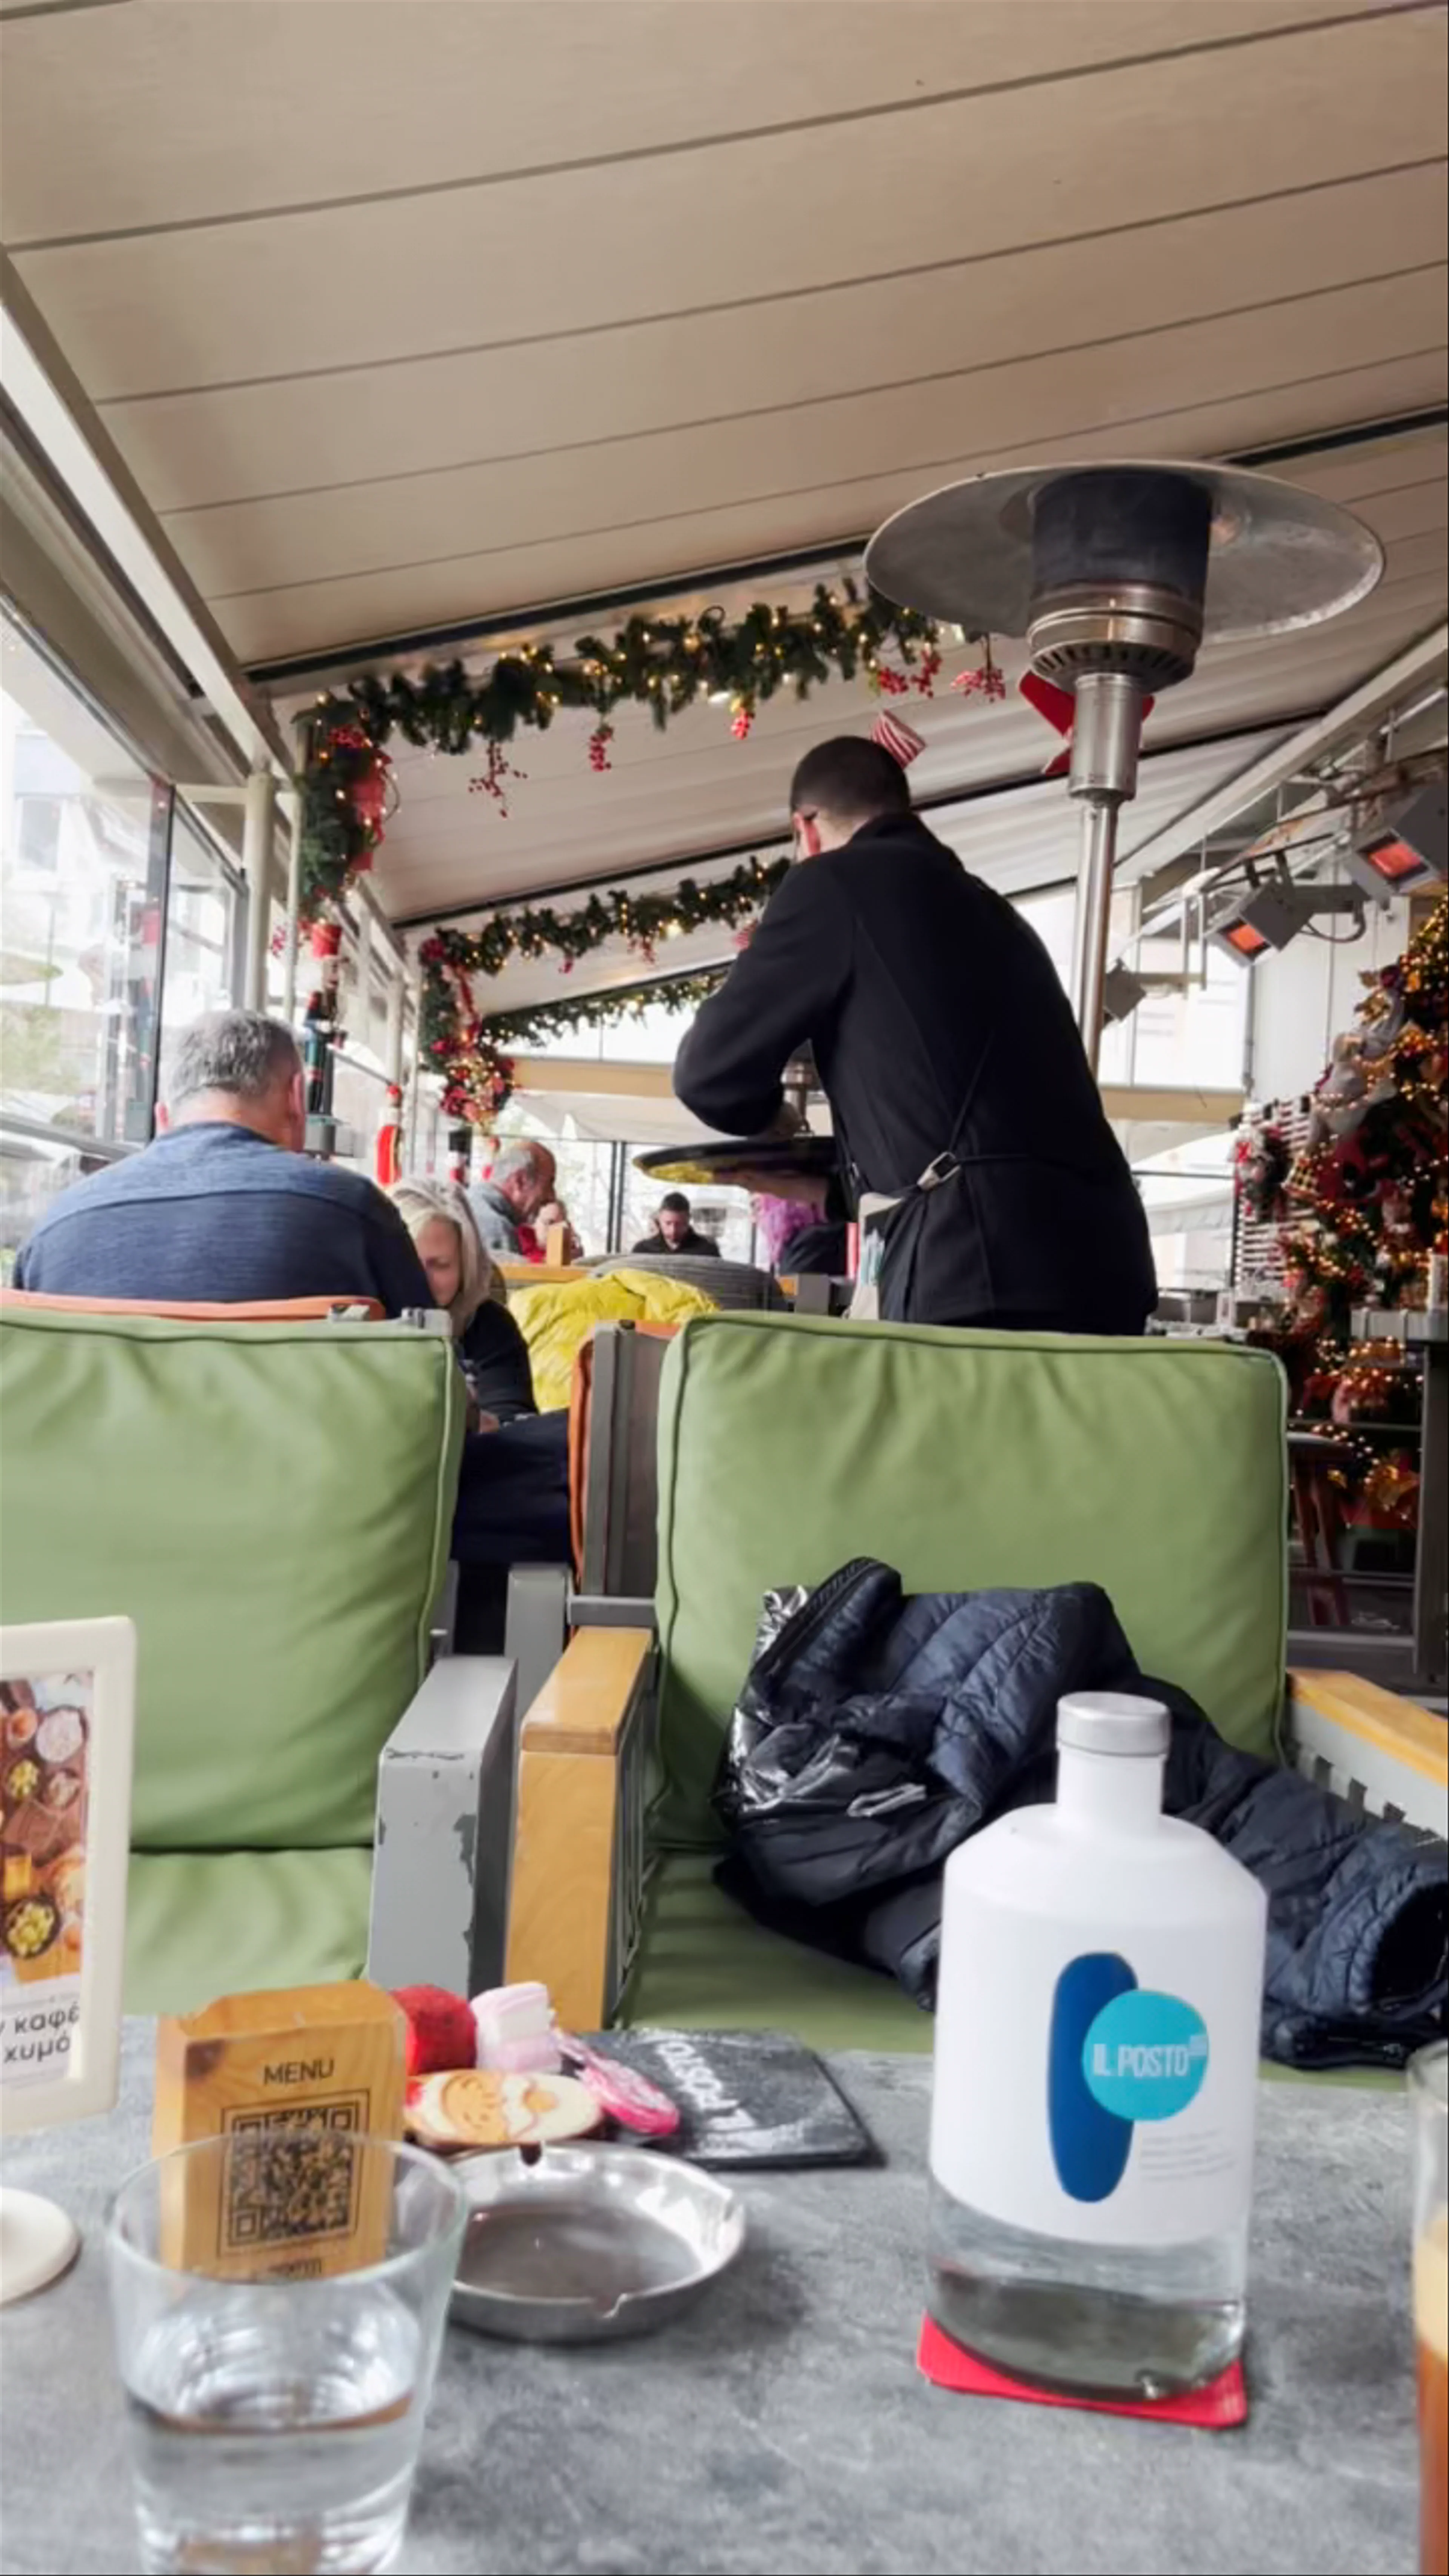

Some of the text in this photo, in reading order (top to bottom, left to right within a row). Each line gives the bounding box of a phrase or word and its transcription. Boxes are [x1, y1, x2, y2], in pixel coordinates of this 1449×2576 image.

[4, 2030, 70, 2063] χυμό
[1093, 2043, 1111, 2076] IL
[1117, 2044, 1189, 2077] POSTO
[264, 2058, 335, 2085] MENU
